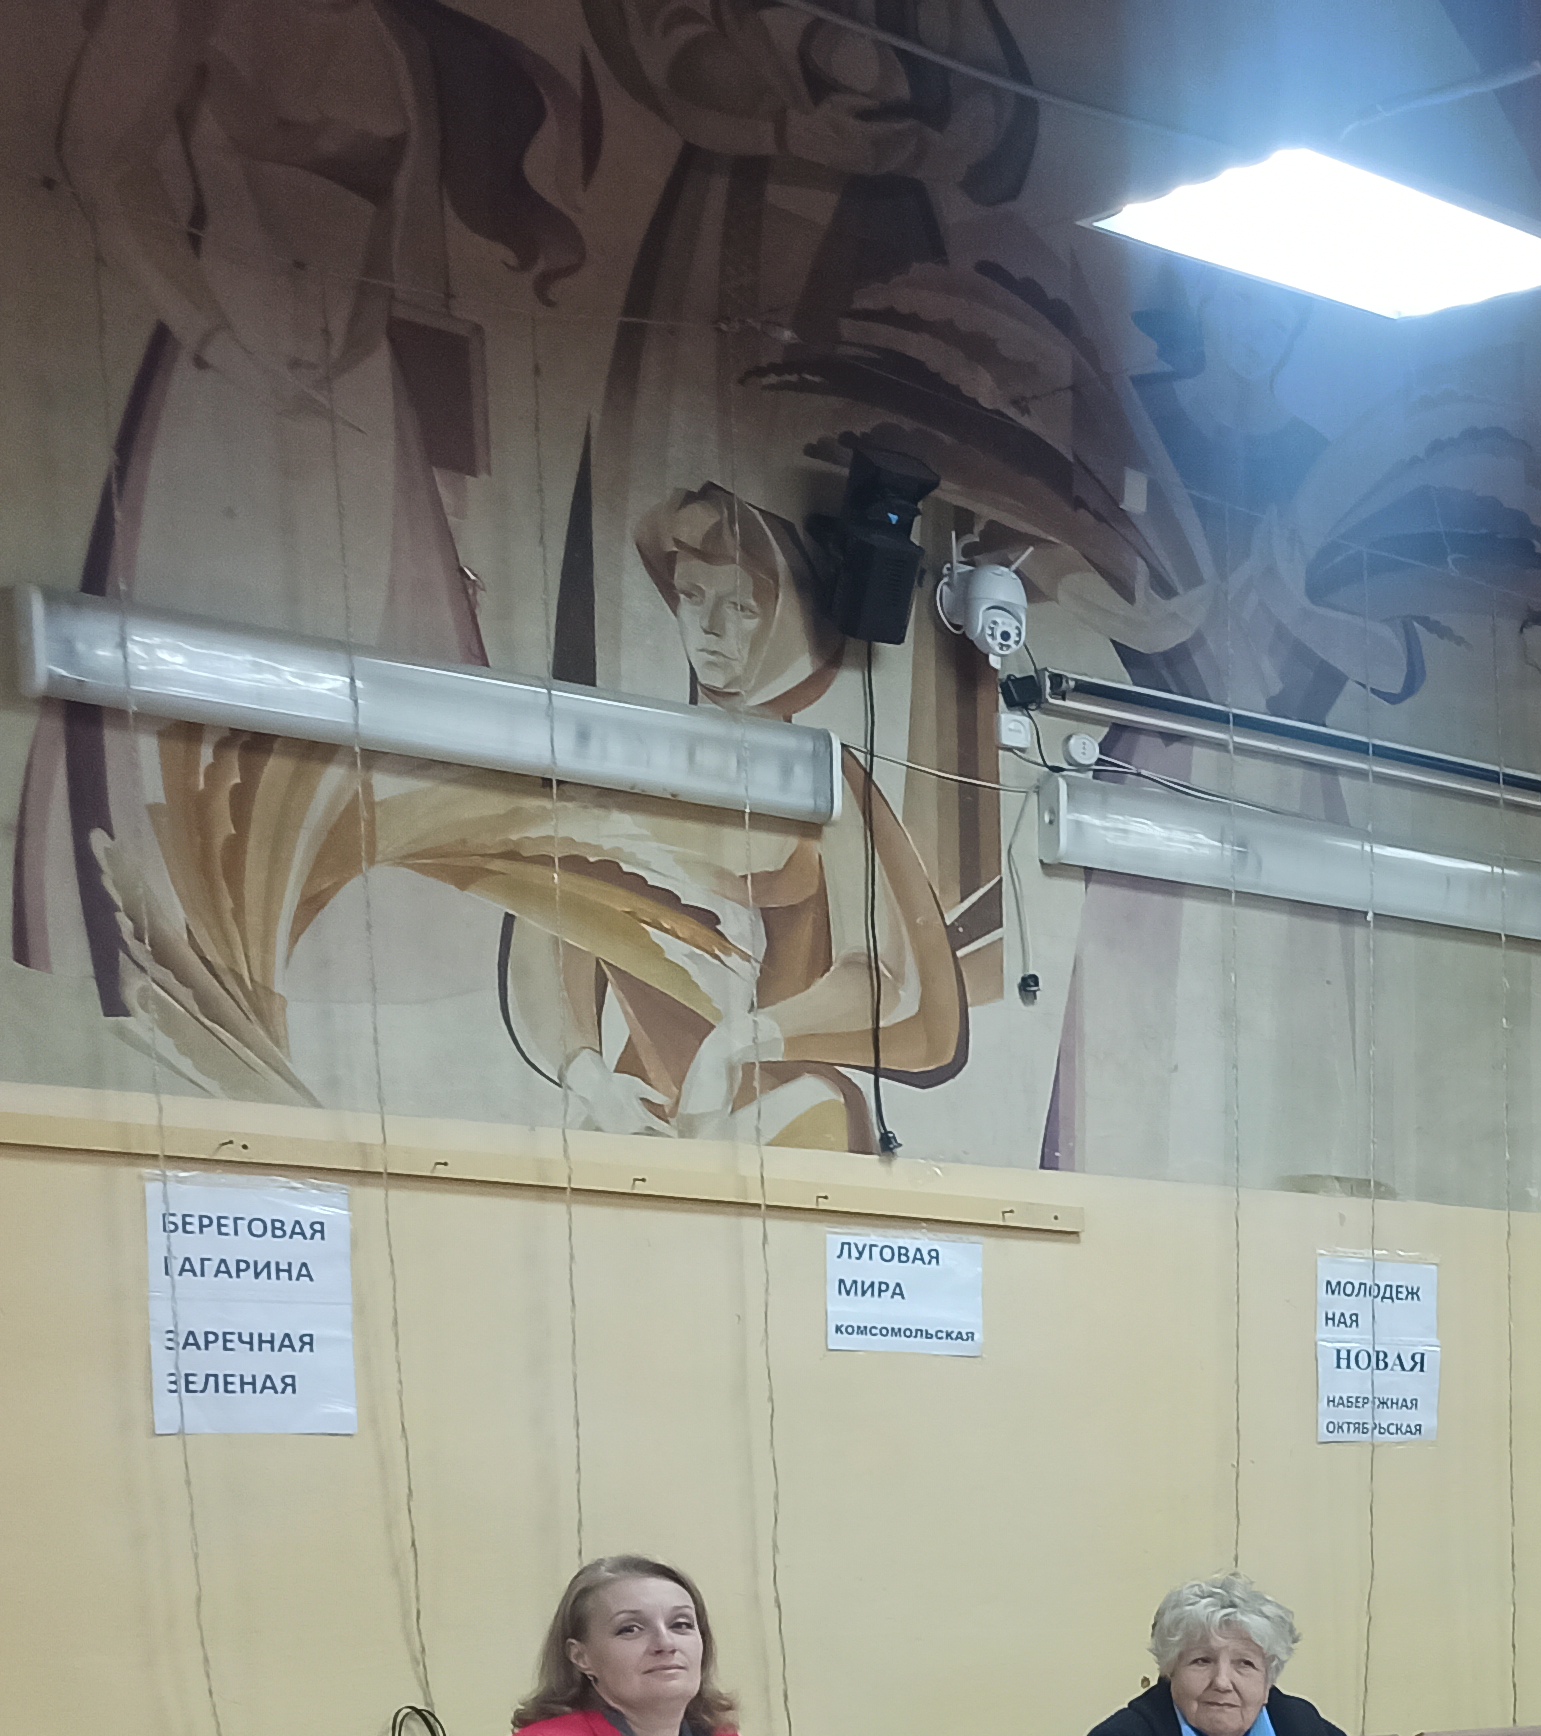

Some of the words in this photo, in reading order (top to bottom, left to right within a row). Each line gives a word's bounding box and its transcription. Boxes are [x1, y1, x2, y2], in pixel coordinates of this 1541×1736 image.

[162, 1212, 326, 1241] БЕРЕГОВАЯ
[836, 1241, 940, 1266] ЛУГОВАЯ
[837, 1278, 906, 1300] МИРА
[1324, 1280, 1421, 1304] МОЛОДЕЖ
[1324, 1311, 1360, 1329] НАЯ
[164, 1329, 315, 1354] ЗАРЕЧНАЯ
[834, 1323, 976, 1342] КОМСОМОЛЬСКАЯ
[1335, 1348, 1426, 1373] НОВАЯ
[166, 1372, 297, 1395] ЗЕЛЕНАЯ
